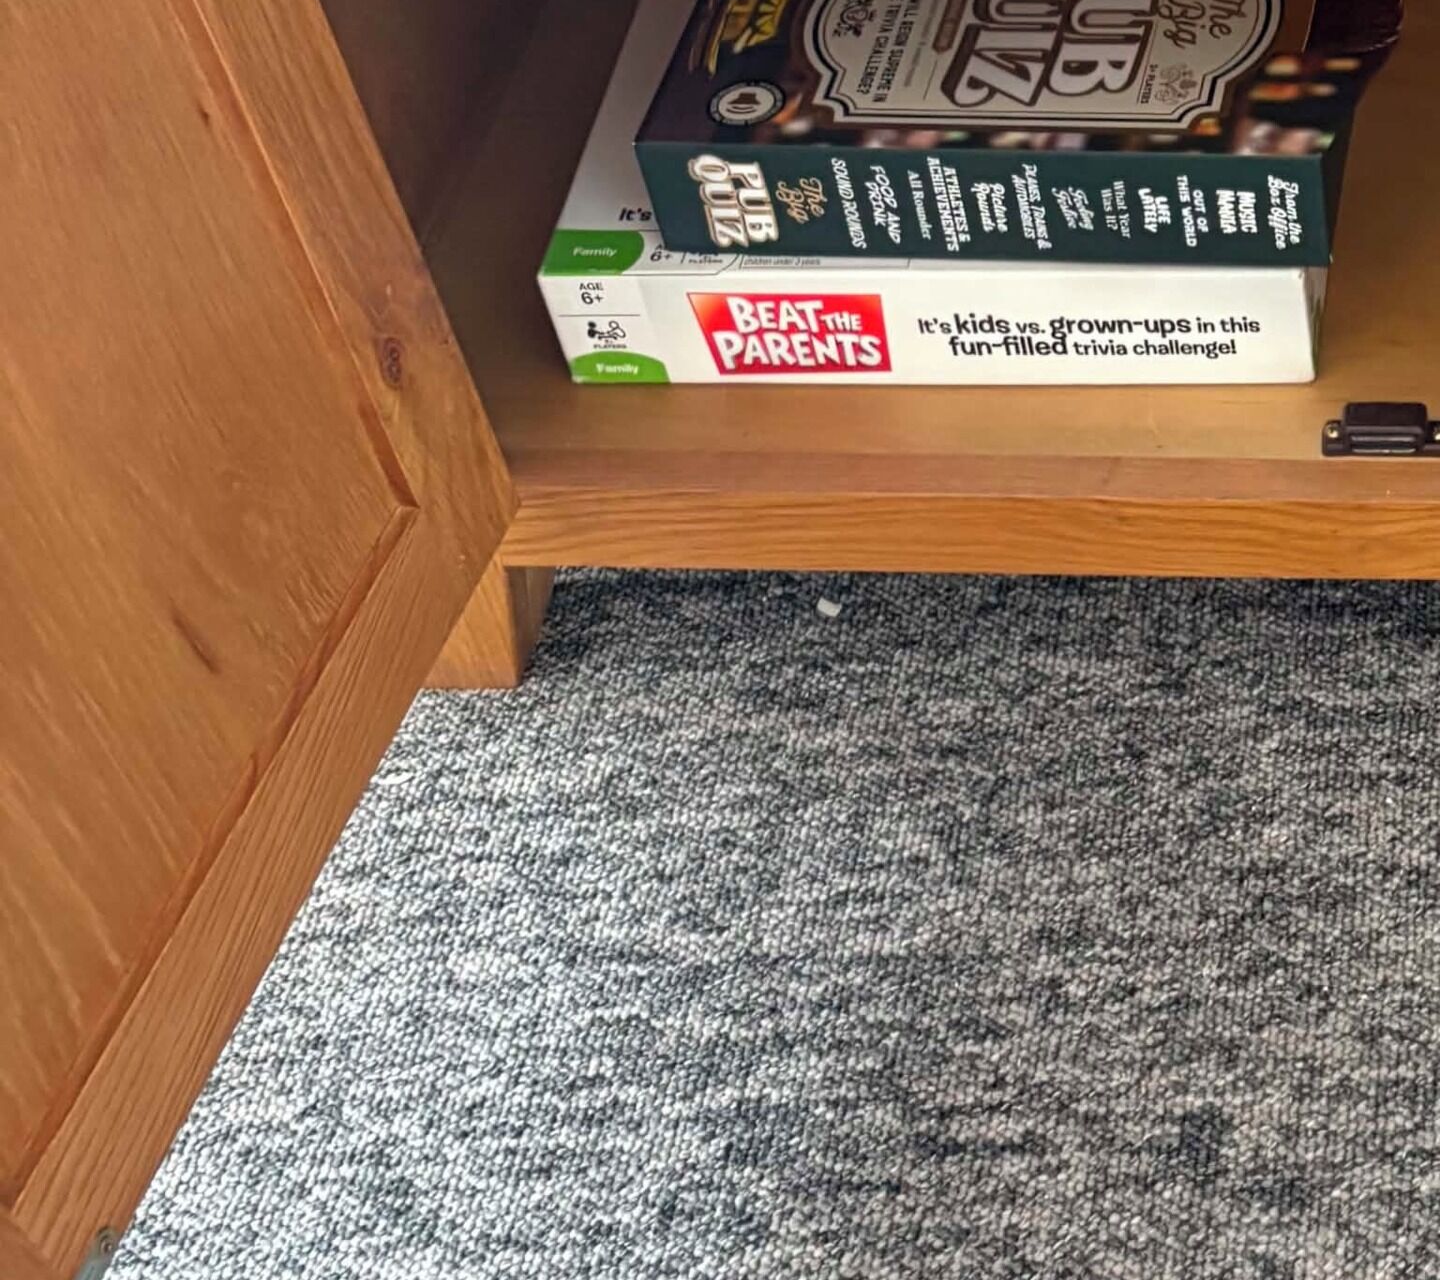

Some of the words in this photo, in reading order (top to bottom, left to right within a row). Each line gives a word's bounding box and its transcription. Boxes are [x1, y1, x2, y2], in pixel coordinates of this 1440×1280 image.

[856, 35, 890, 96] CHALLENGE?
[800, 177, 828, 219] The
[831, 157, 856, 200] SOUND
[907, 170, 921, 188] All
[1113, 180, 1129, 211] What
[1176, 175, 1191, 203] THIS
[1267, 175, 1285, 205] Box
[619, 207, 653, 222] It's
[688, 153, 750, 248] QUIZ
[726, 160, 781, 242] PUB
[776, 180, 810, 225] Big
[870, 164, 899, 208] FOOD
[886, 211, 902, 245] AND
[927, 156, 960, 252] ACHIEVEMENTS
[943, 166, 969, 231] ATHLETES
[970, 181, 996, 233] Rounds
[989, 182, 1009, 233] Picture
[1100, 188, 1114, 212] Was
[1137, 187, 1158, 234] LATELY
[1154, 195, 1172, 225] LIFE
[1192, 189, 1207, 214] OUT
[1216, 189, 1238, 235] MANIA
[1236, 190, 1259, 234] MUSIC
[841, 198, 868, 250] ROUNDS
[1118, 211, 1132, 239] Year
[1181, 206, 1198, 248] WORLD
[1196, 216, 1209, 234] OF
[1288, 222, 1304, 245] the
[572, 246, 618, 259] Family
[650, 251, 672, 263] 6+
[579, 282, 604, 293] AGE
[581, 292, 604, 305] 6+
[727, 296, 823, 335] BEAT
[821, 308, 863, 333] THE
[917, 318, 952, 335] It's
[953, 313, 1010, 335] kids
[1015, 321, 1046, 336] vs.
[1049, 316, 1192, 340] grown-ups
[1196, 317, 1215, 334] in
[1219, 317, 1261, 334] this
[713, 329, 884, 371] PARENTS
[949, 335, 1068, 358] fun-filled
[1073, 339, 1128, 357] trivia
[1132, 338, 1238, 359] challenge!
